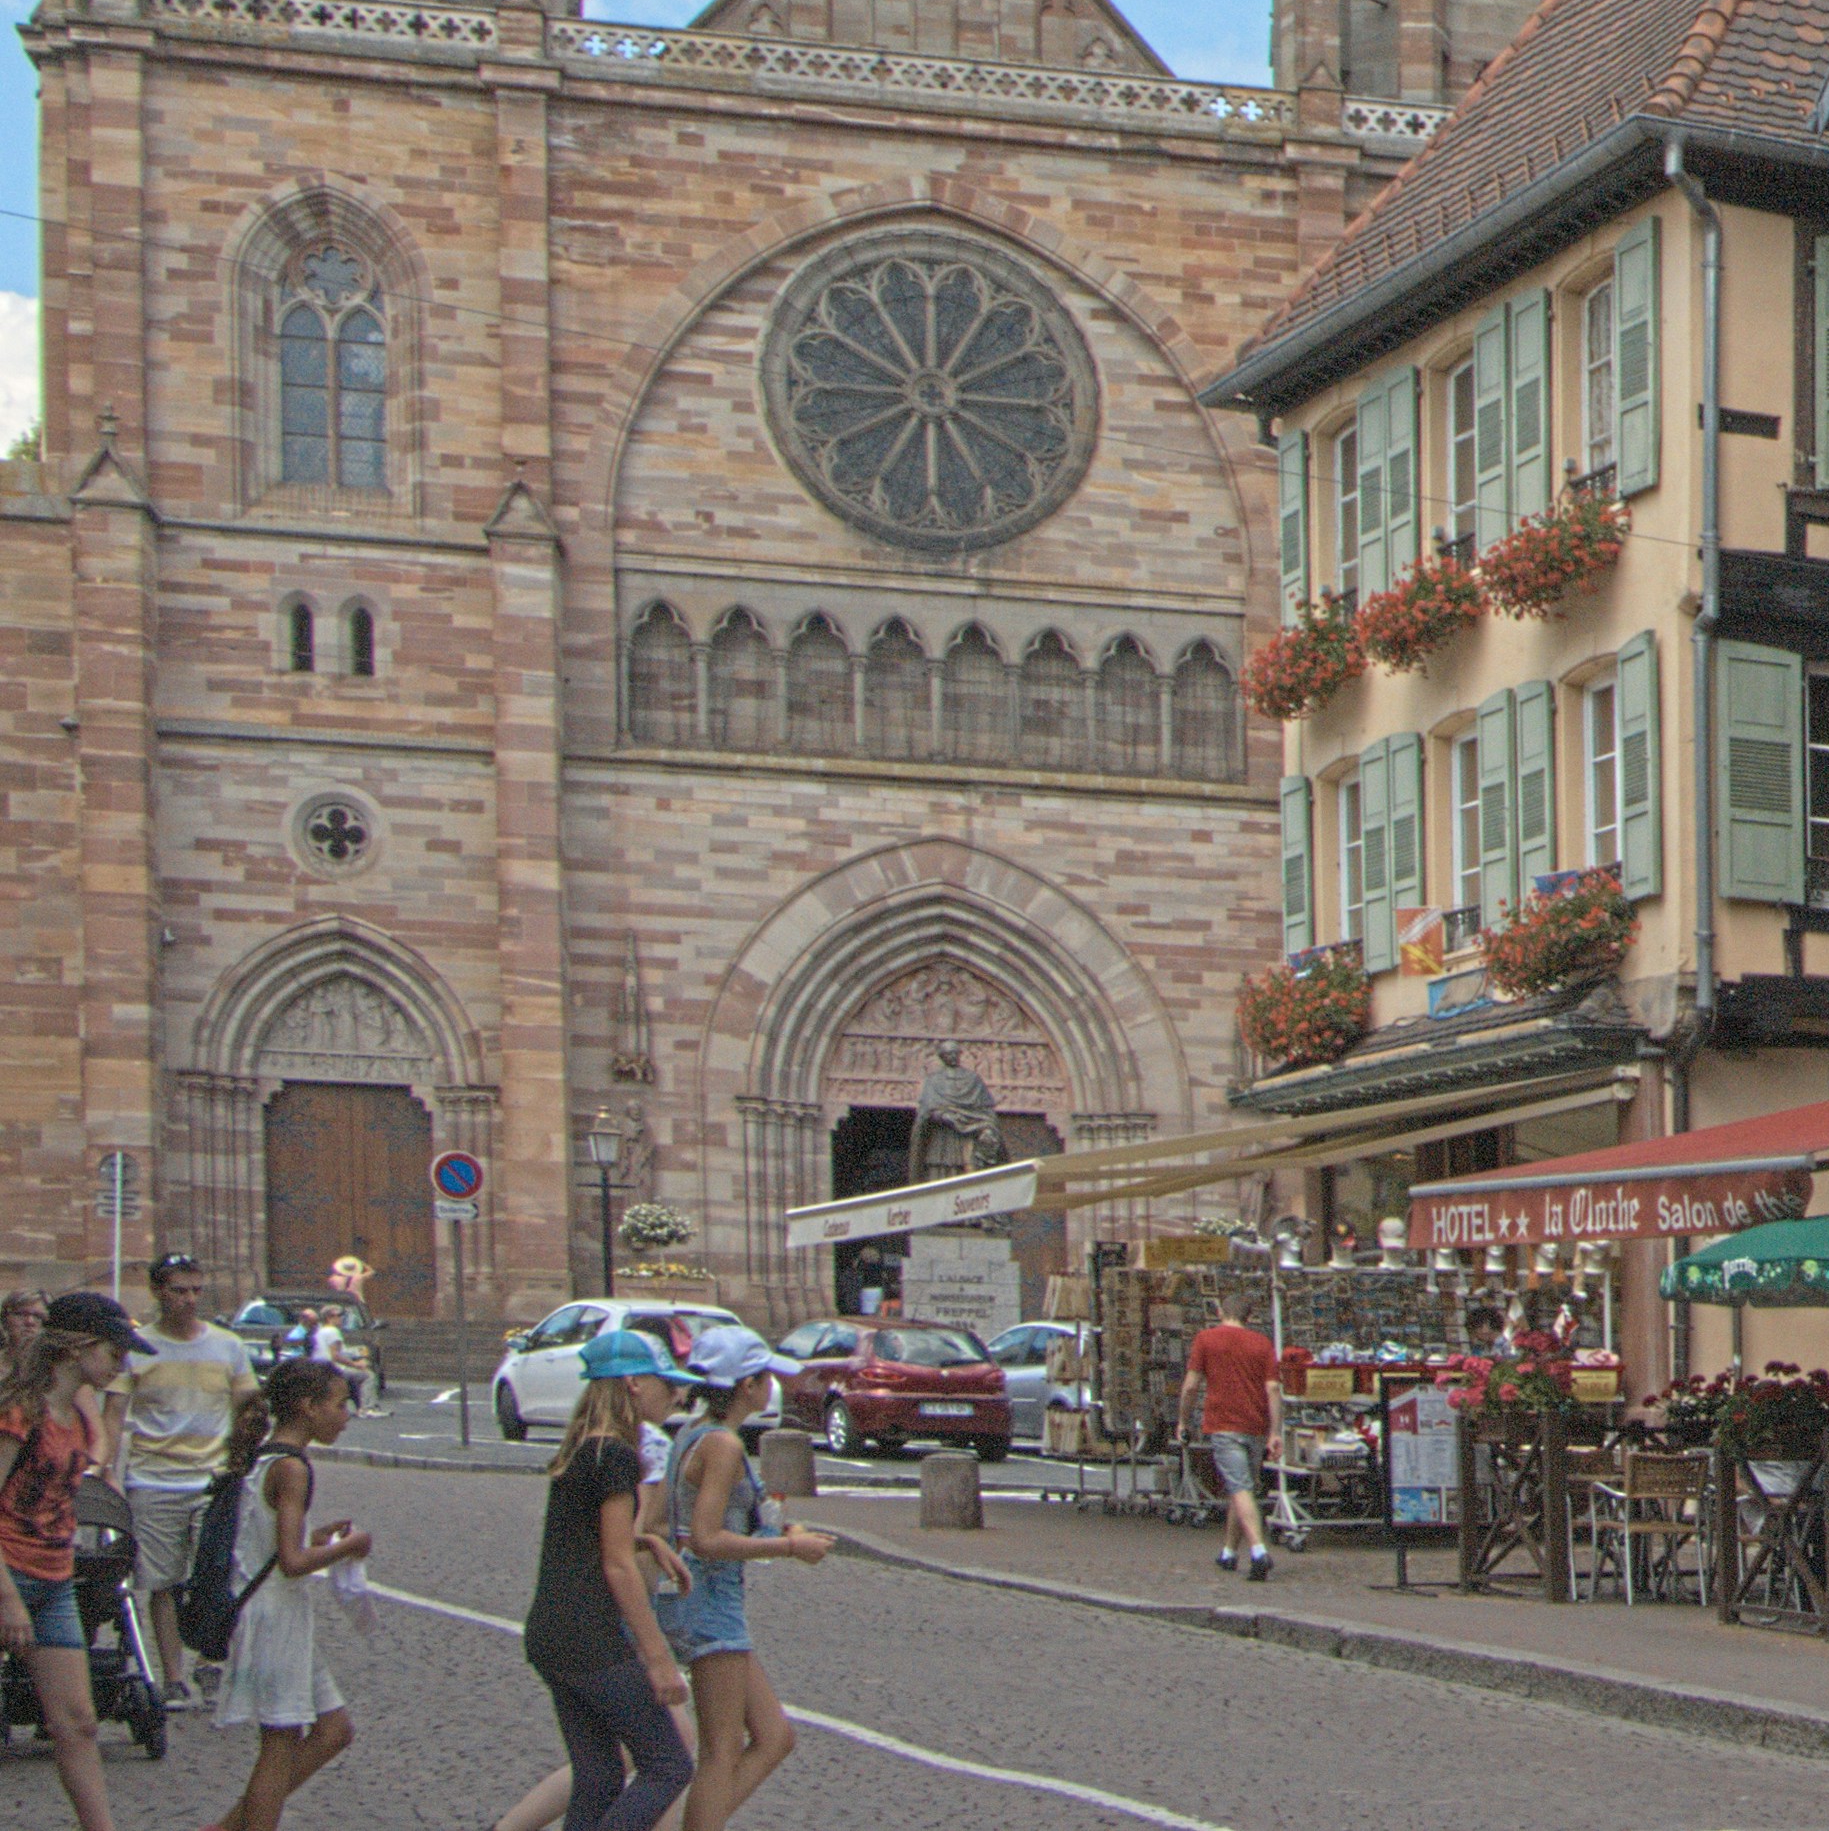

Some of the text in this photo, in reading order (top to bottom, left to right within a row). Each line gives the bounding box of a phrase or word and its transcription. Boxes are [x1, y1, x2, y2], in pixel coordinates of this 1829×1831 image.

[1431, 1204, 1496, 1244] HOTEL
[1568, 1186, 1641, 1234] Cloche
[1656, 1195, 1720, 1232] Salon
[1722, 1192, 1753, 1227] de
